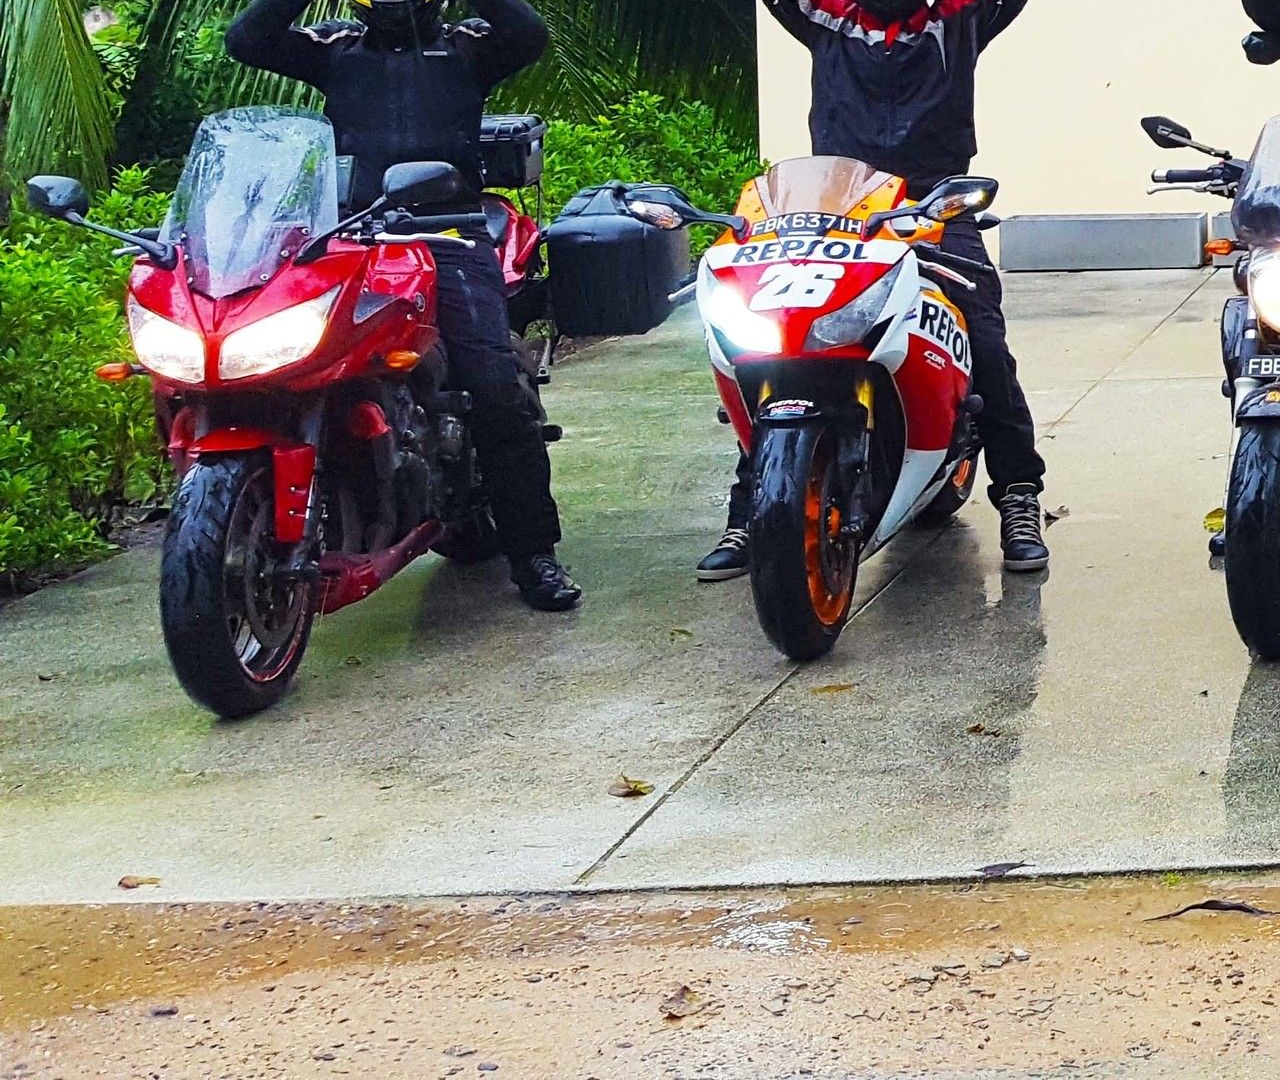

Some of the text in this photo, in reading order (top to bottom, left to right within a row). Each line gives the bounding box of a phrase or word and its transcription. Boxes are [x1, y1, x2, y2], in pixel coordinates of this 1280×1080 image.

[751, 213, 862, 236] FBK6371H
[731, 239, 869, 263] REPSOL
[748, 262, 845, 312] 26
[919, 300, 970, 370] REPOL
